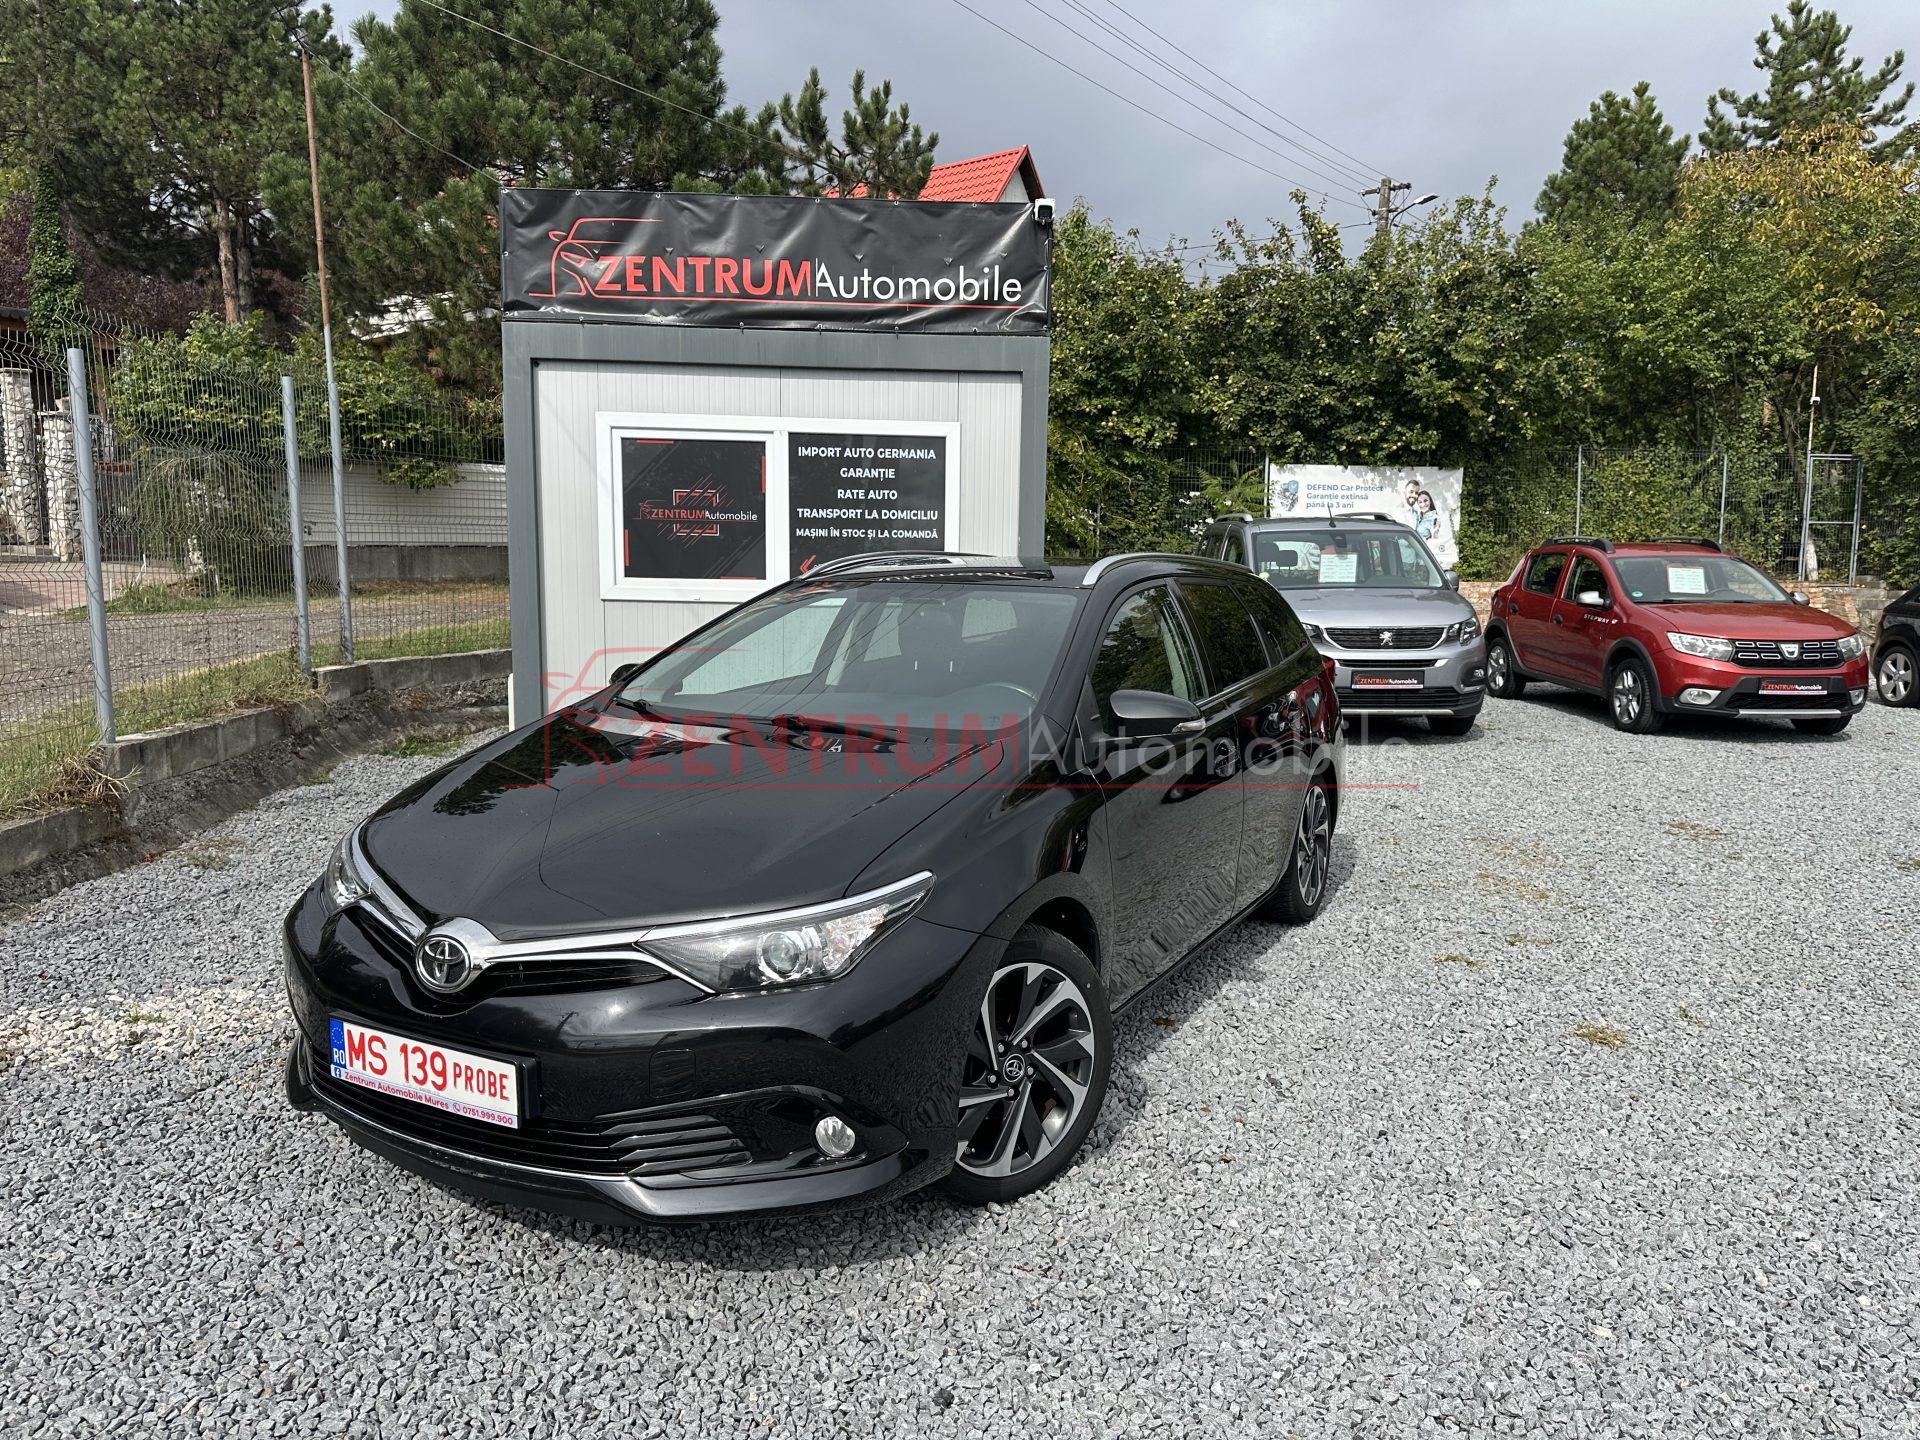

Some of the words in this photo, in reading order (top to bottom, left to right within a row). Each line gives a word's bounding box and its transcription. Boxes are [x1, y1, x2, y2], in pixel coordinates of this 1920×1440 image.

[595, 256, 812, 297] ZENTRUM
[798, 447, 842, 458] IMPORT
[844, 448, 875, 459] AUTO
[877, 448, 937, 460] GERMANIA
[840, 468, 896, 481] GARANȚIE
[1306, 483, 1339, 491] DEFEND
[838, 489, 865, 500] RATE
[868, 490, 898, 500] AUTO
[797, 508, 863, 519] TRANSPORT
[865, 510, 879, 519] LA
[881, 510, 938, 520] DOMICILIU
[830, 526, 840, 537] ÎN
[842, 529, 866, 538] STOC
[878, 530, 890, 538] LA
[891, 529, 939, 539] COMANDĂ
[1584, 613, 1610, 624] STEPWAY
[332, 1047, 346, 1065] RO
[346, 1028, 388, 1076] MS
[399, 1043, 448, 1092] 139
[453, 1061, 510, 1101] PROBE
[344, 1071, 376, 1088] Zentrum
[377, 1083, 423, 1102] Automobile
[424, 1096, 450, 1109] Mures
[462, 1106, 513, 1125] 0751.999.900
